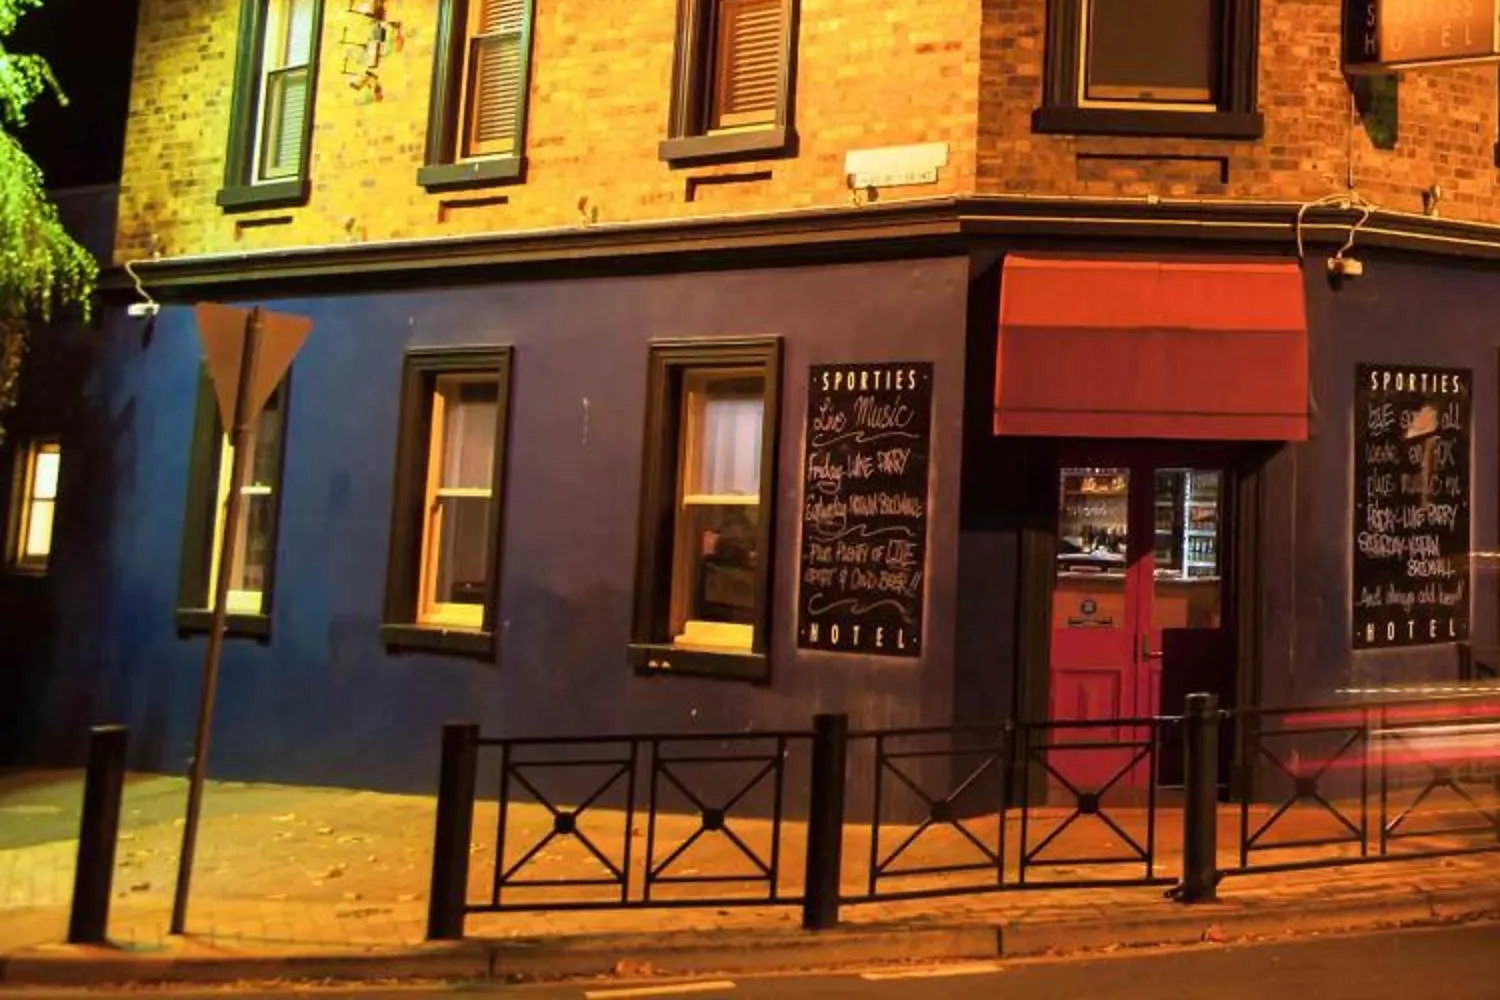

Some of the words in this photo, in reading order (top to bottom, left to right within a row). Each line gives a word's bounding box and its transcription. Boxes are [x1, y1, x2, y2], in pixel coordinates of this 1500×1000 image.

[822, 369, 916, 391] SPORTIES
[1371, 371, 1459, 393] SPORTIES
[854, 395, 915, 429] Music
[810, 622, 905, 649] HOTEL
[1366, 617, 1456, 643] HOTEL
